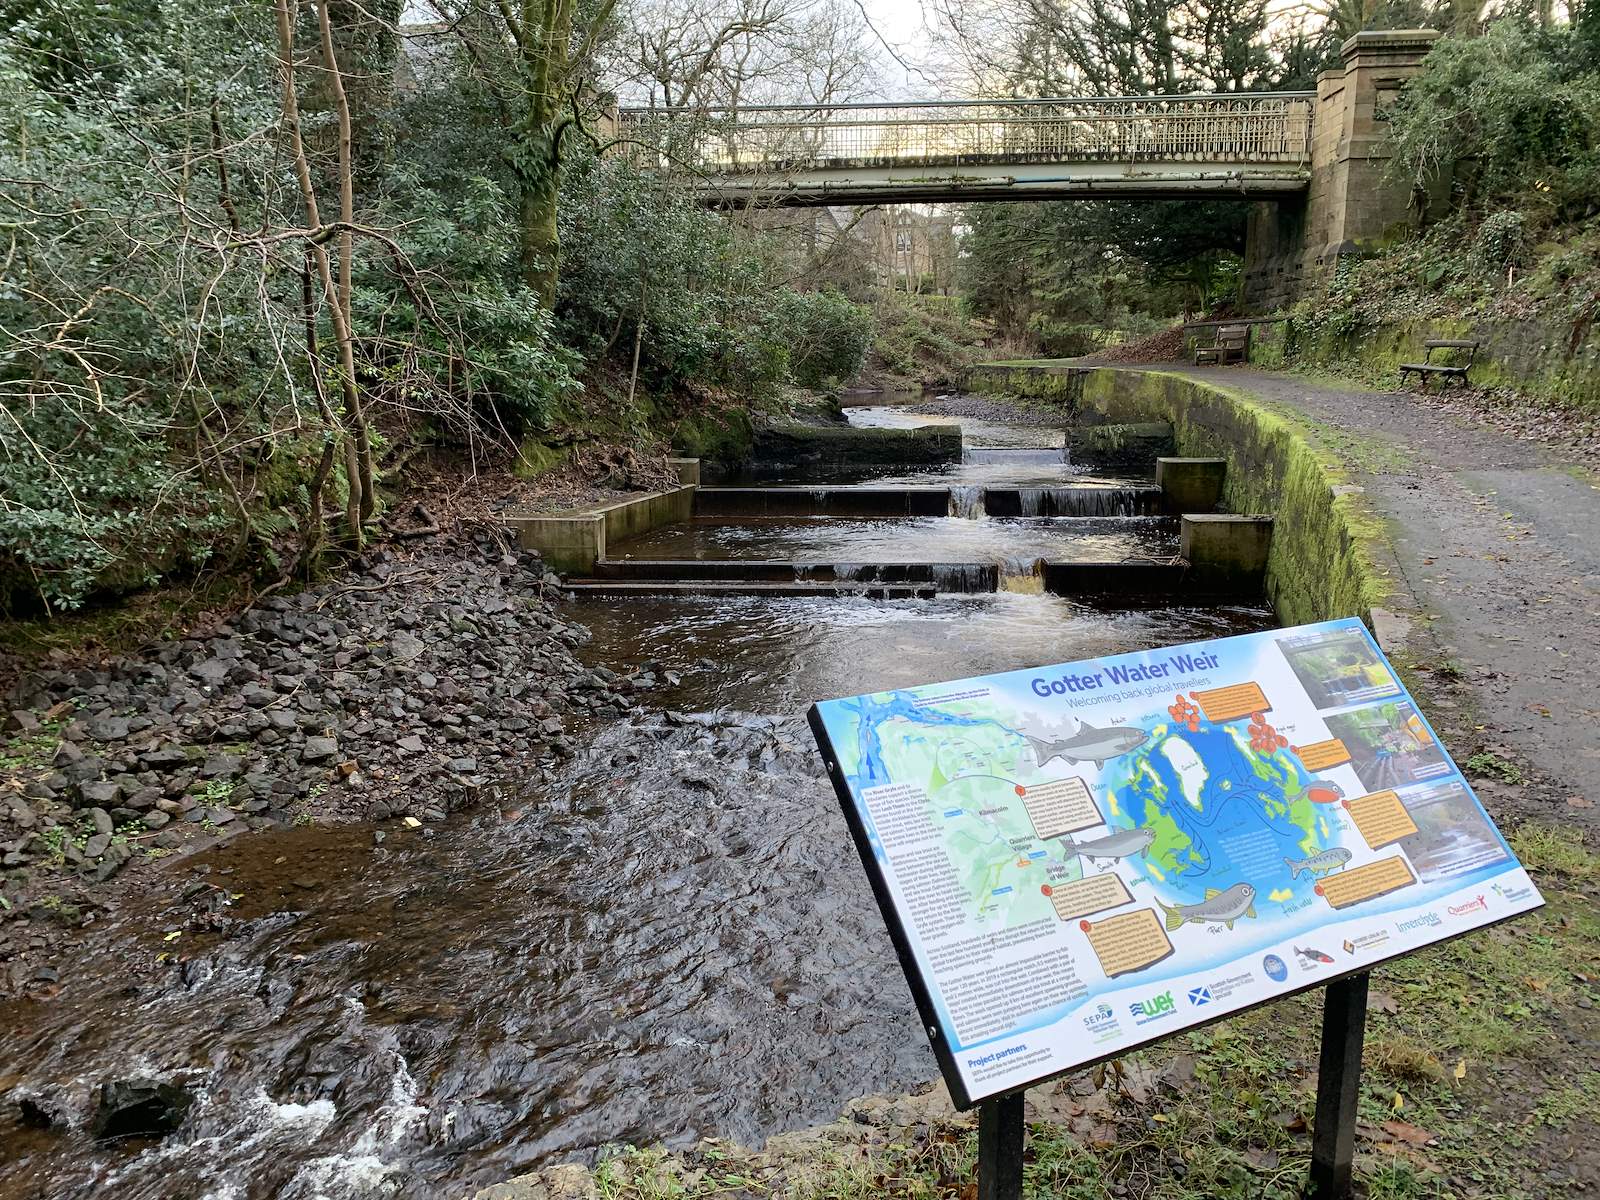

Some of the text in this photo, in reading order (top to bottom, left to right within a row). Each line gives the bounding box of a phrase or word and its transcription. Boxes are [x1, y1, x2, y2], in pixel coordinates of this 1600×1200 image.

[1029, 651, 1222, 697] Gotter Water Weir
[1066, 677, 1211, 708] Welcoming back global travellers
[978, 805, 1009, 816] Kilmacolm
[1008, 835, 1035, 844] Quarriers
[1012, 843, 1032, 851] Village
[1055, 871, 1070, 879] Weir
[1446, 900, 1479, 916] Quarriers
[1394, 911, 1439, 931] Inverclyde
[1141, 990, 1177, 1017] wef
[1083, 1011, 1110, 1026] SEPA
[967, 1044, 1027, 1067] Project partners
